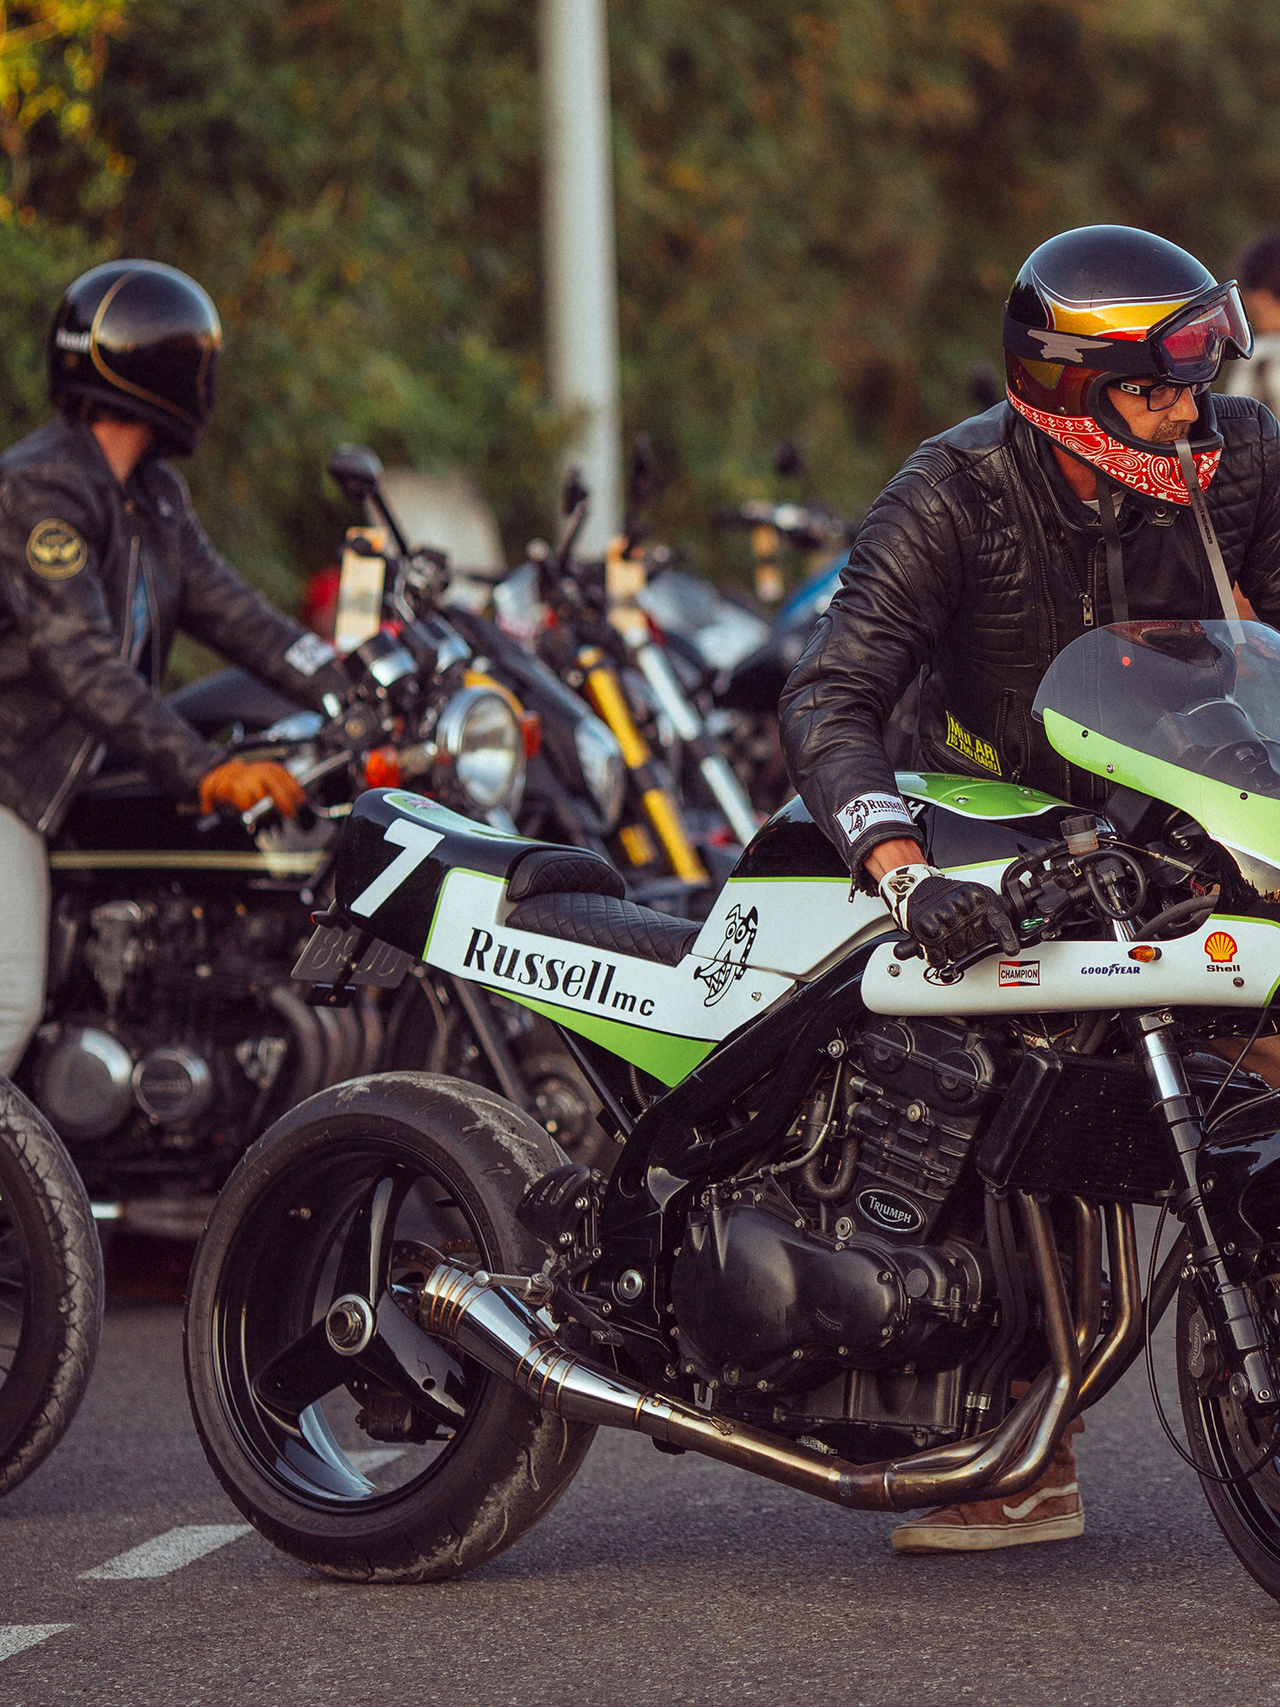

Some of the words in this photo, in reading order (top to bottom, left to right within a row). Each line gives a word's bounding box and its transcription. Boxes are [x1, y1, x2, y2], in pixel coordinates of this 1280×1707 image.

[350, 817, 446, 919] 7
[1000, 969, 1038, 979] CHAMPION
[1206, 964, 1241, 972] Shell
[869, 1195, 912, 1223] TRIUMPH
